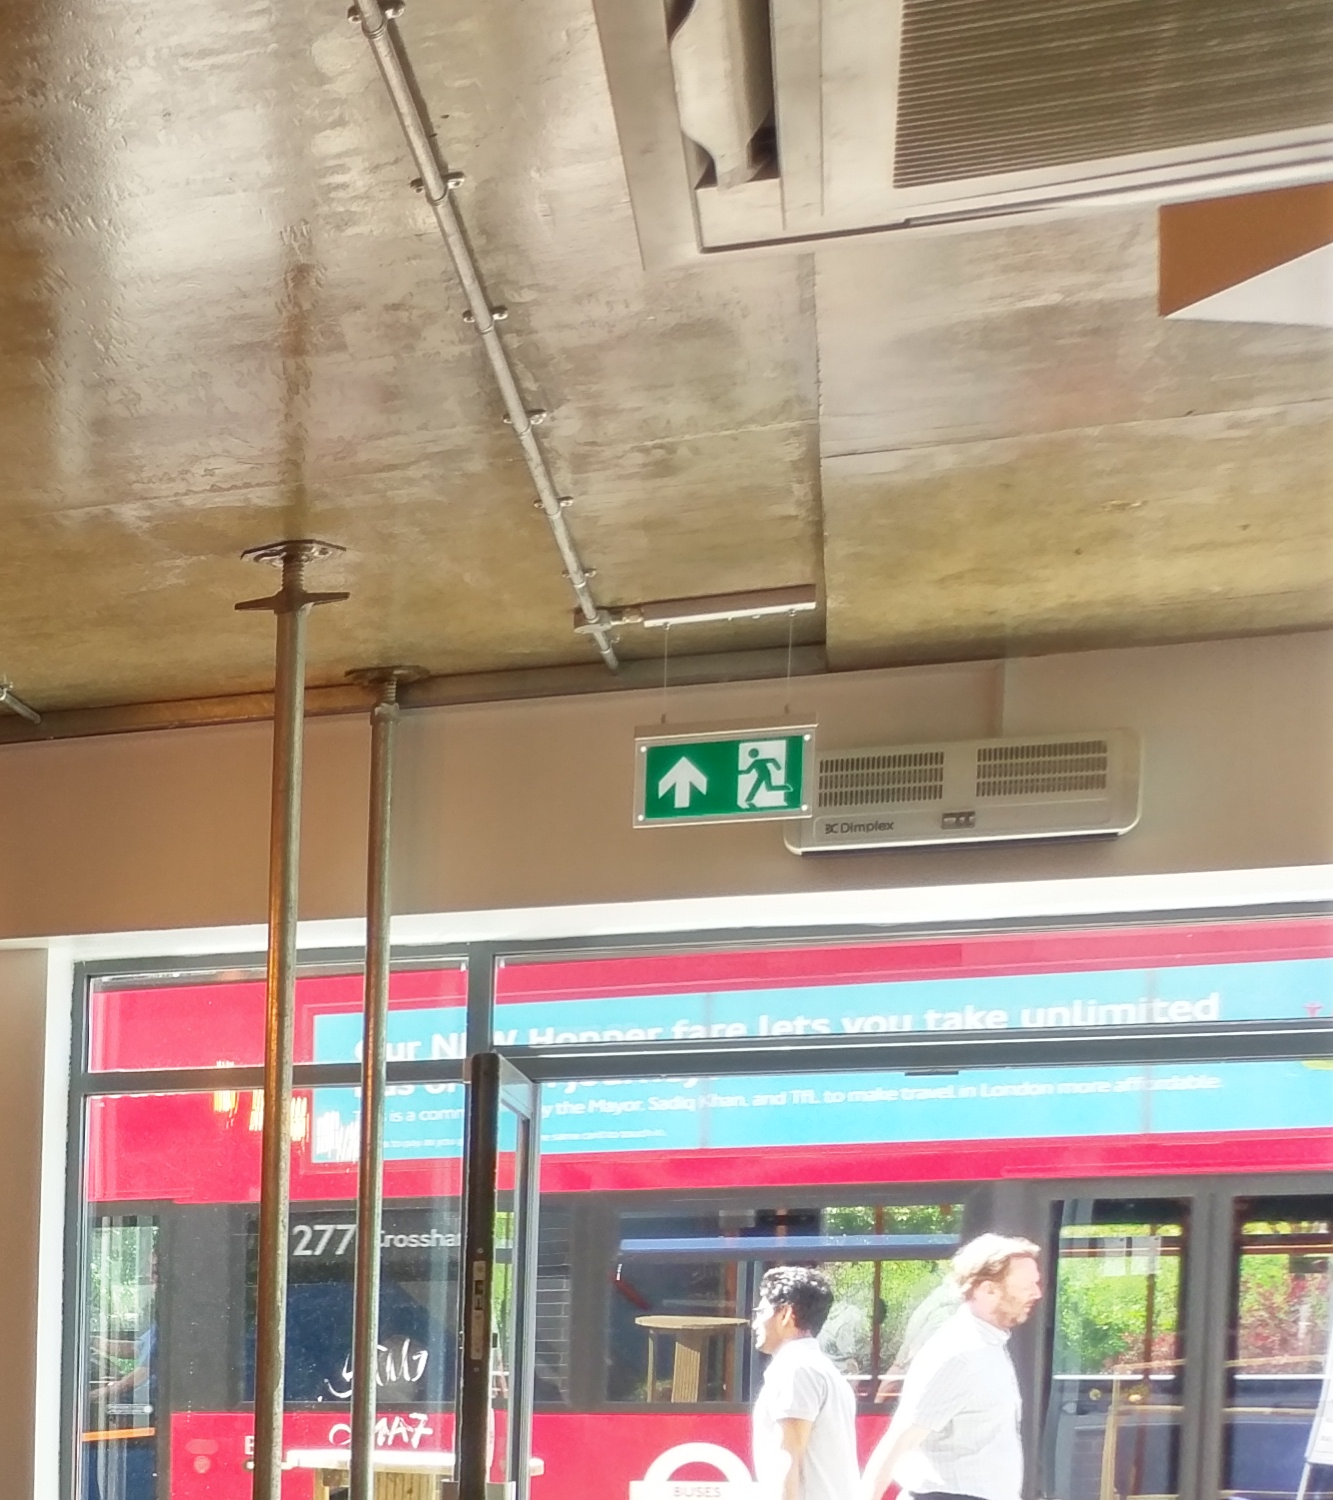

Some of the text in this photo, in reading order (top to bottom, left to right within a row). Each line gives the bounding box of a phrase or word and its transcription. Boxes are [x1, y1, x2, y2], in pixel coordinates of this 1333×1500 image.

[839, 819, 895, 834] Dimplex
[432, 1028, 518, 1060] NW
[671, 1018, 748, 1040] fare
[759, 1014, 830, 1038] lets
[841, 1012, 912, 1035] you
[924, 1005, 1008, 1031] take
[1020, 992, 1221, 1028] unlimited
[554, 1100, 586, 1116] the
[647, 1096, 696, 1114] Sadiq
[752, 1091, 787, 1107] and
[823, 1090, 845, 1104] to
[847, 1087, 899, 1103] make
[901, 1084, 955, 1101] travel
[957, 1084, 977, 1099] in
[980, 1081, 1054, 1098] London
[1056, 1081, 1111, 1095] more
[1113, 1074, 1222, 1092] affordable
[292, 1224, 357, 1256] 277
[673, 1486, 722, 1498] BUSES
